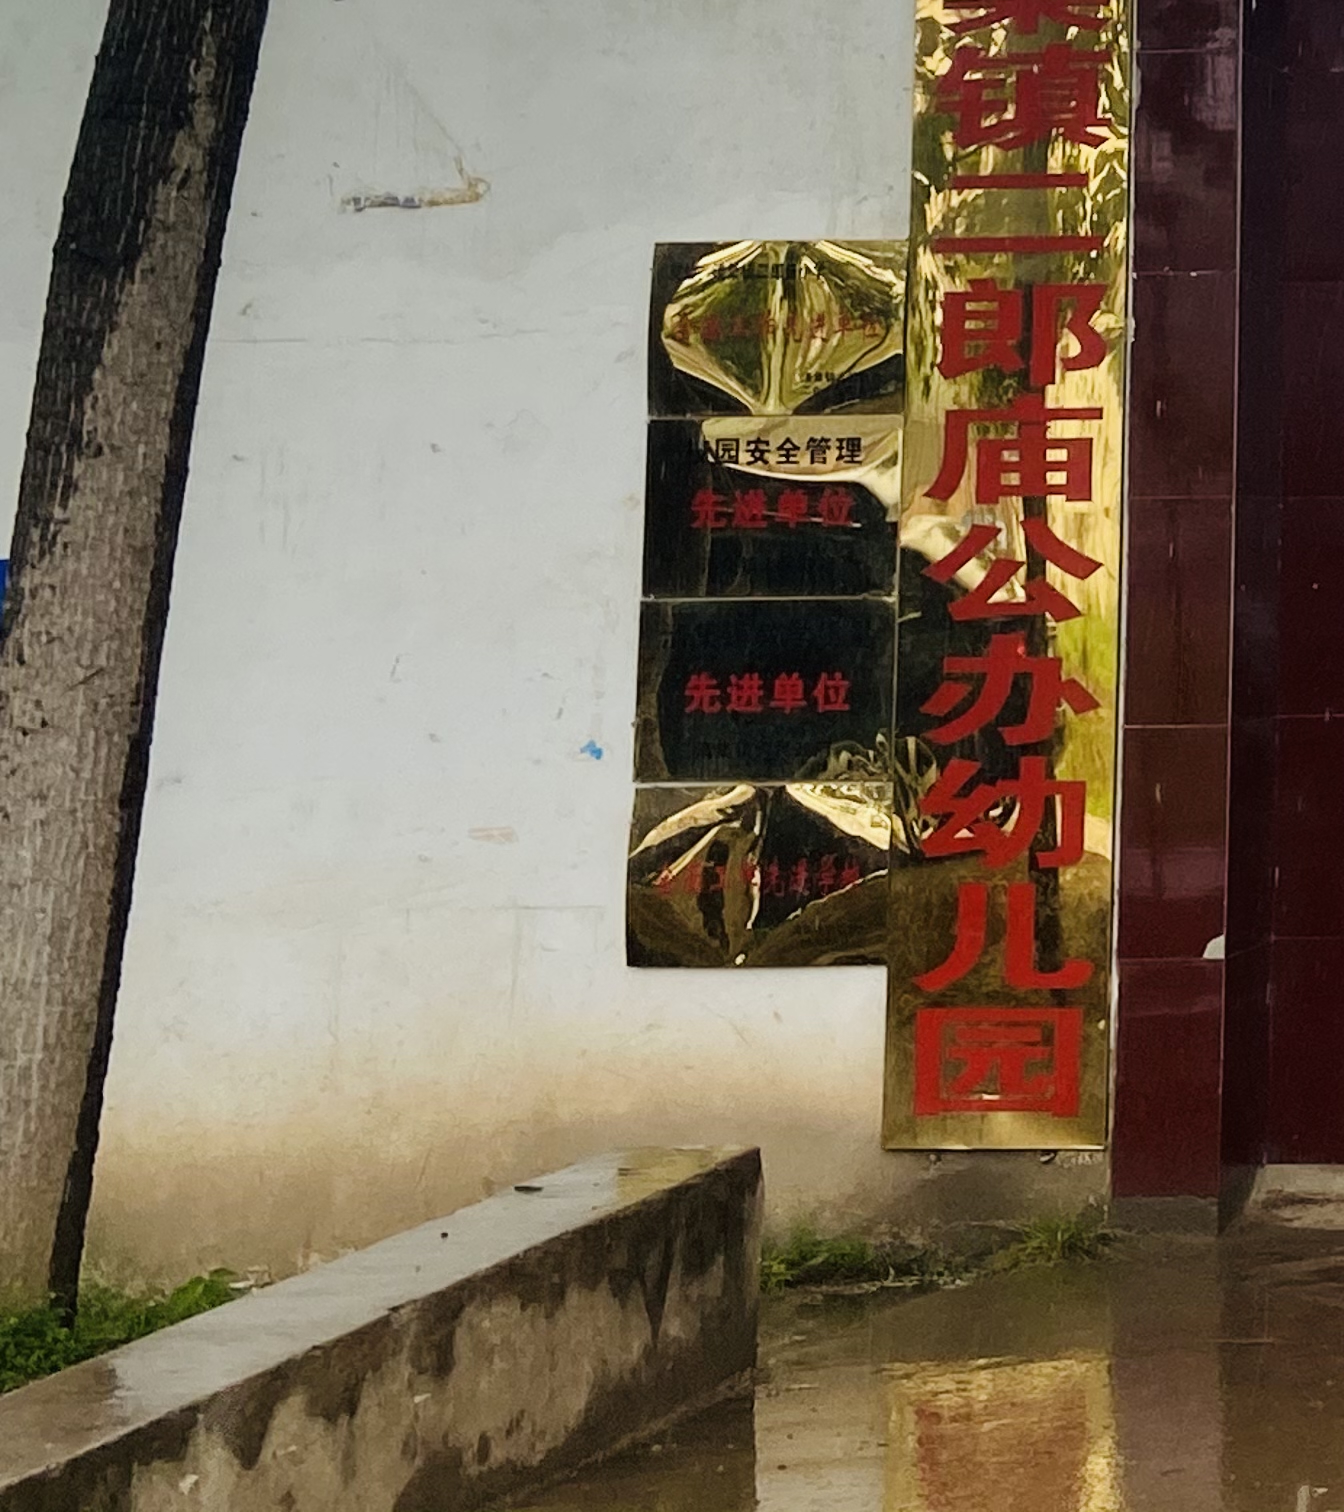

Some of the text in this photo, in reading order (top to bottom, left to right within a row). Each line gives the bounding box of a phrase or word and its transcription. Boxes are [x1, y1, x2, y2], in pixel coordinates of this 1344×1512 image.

[690, 487, 855, 529] 先进单位
[684, 671, 850, 714] 先进单位
